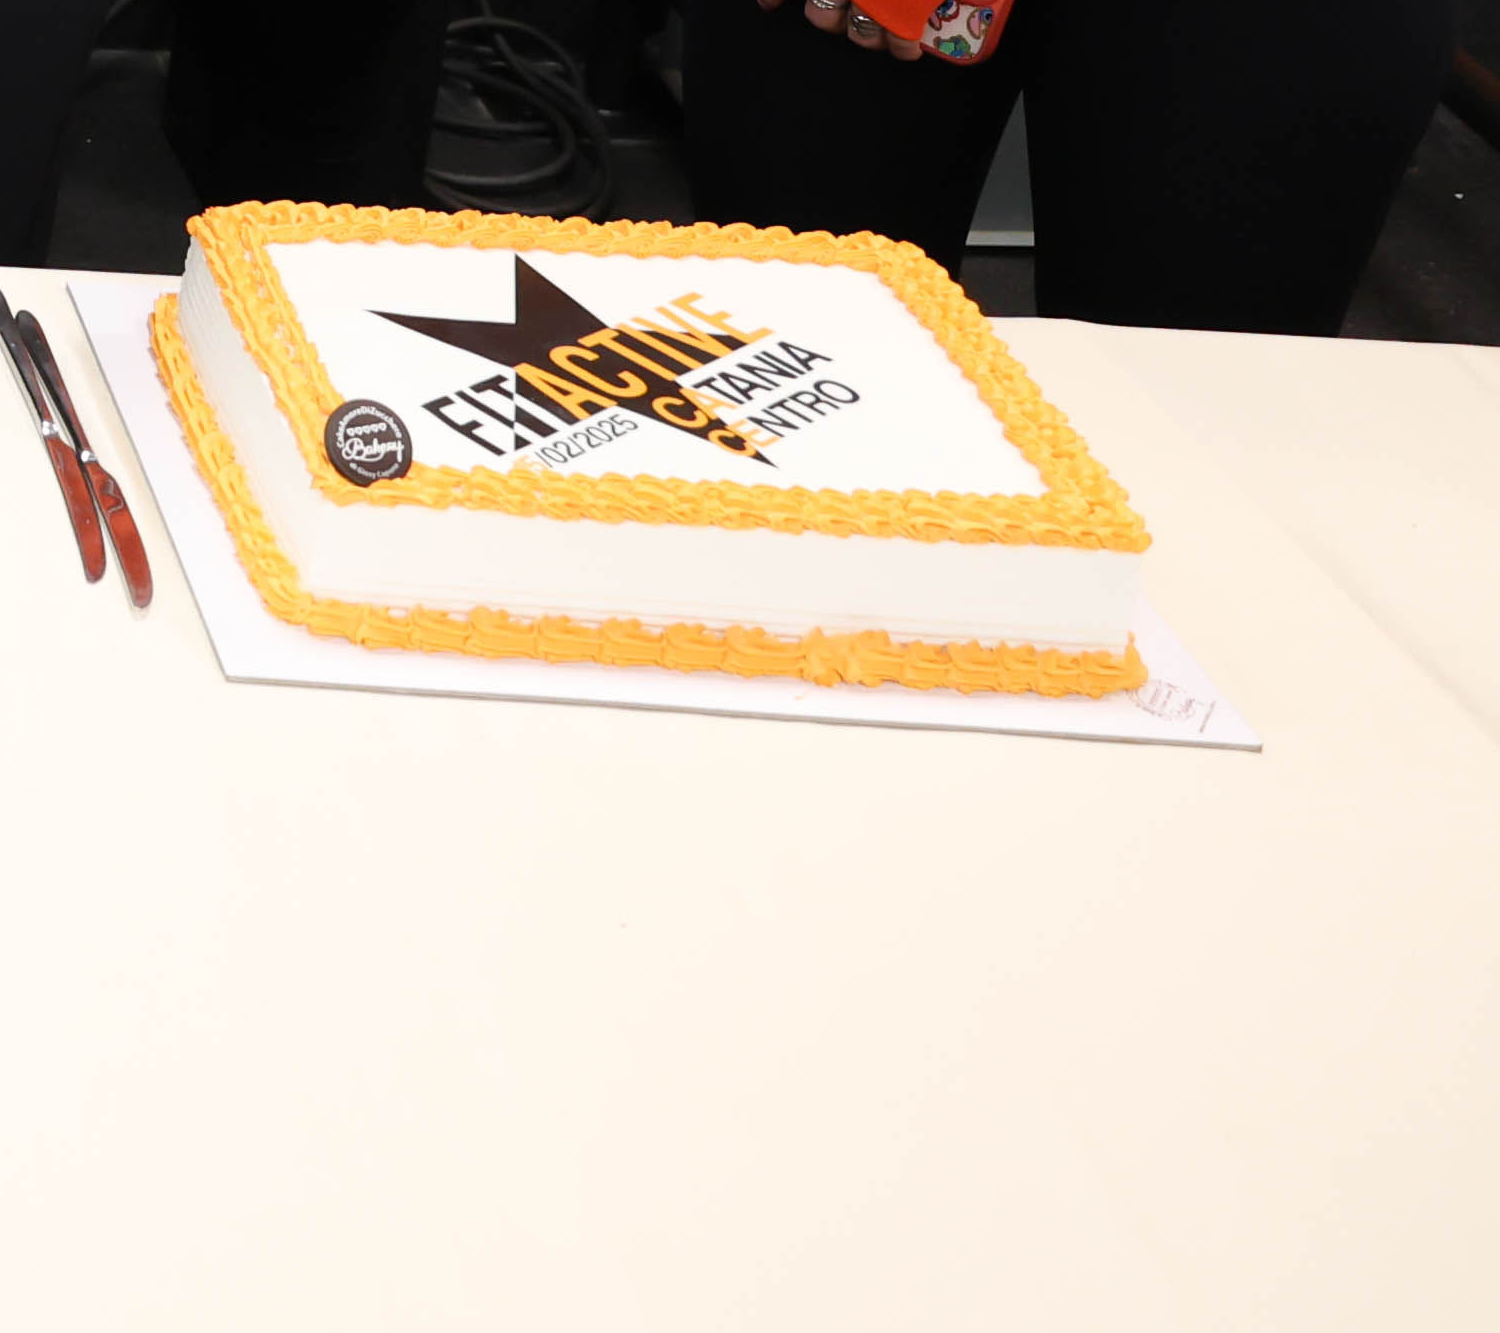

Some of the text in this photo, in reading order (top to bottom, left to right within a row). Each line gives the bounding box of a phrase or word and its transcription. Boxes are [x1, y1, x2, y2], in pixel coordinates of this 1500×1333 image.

[421, 291, 776, 457] FITACTIVE
[651, 340, 835, 430] CATANIA
[707, 379, 861, 458] CENTRO
